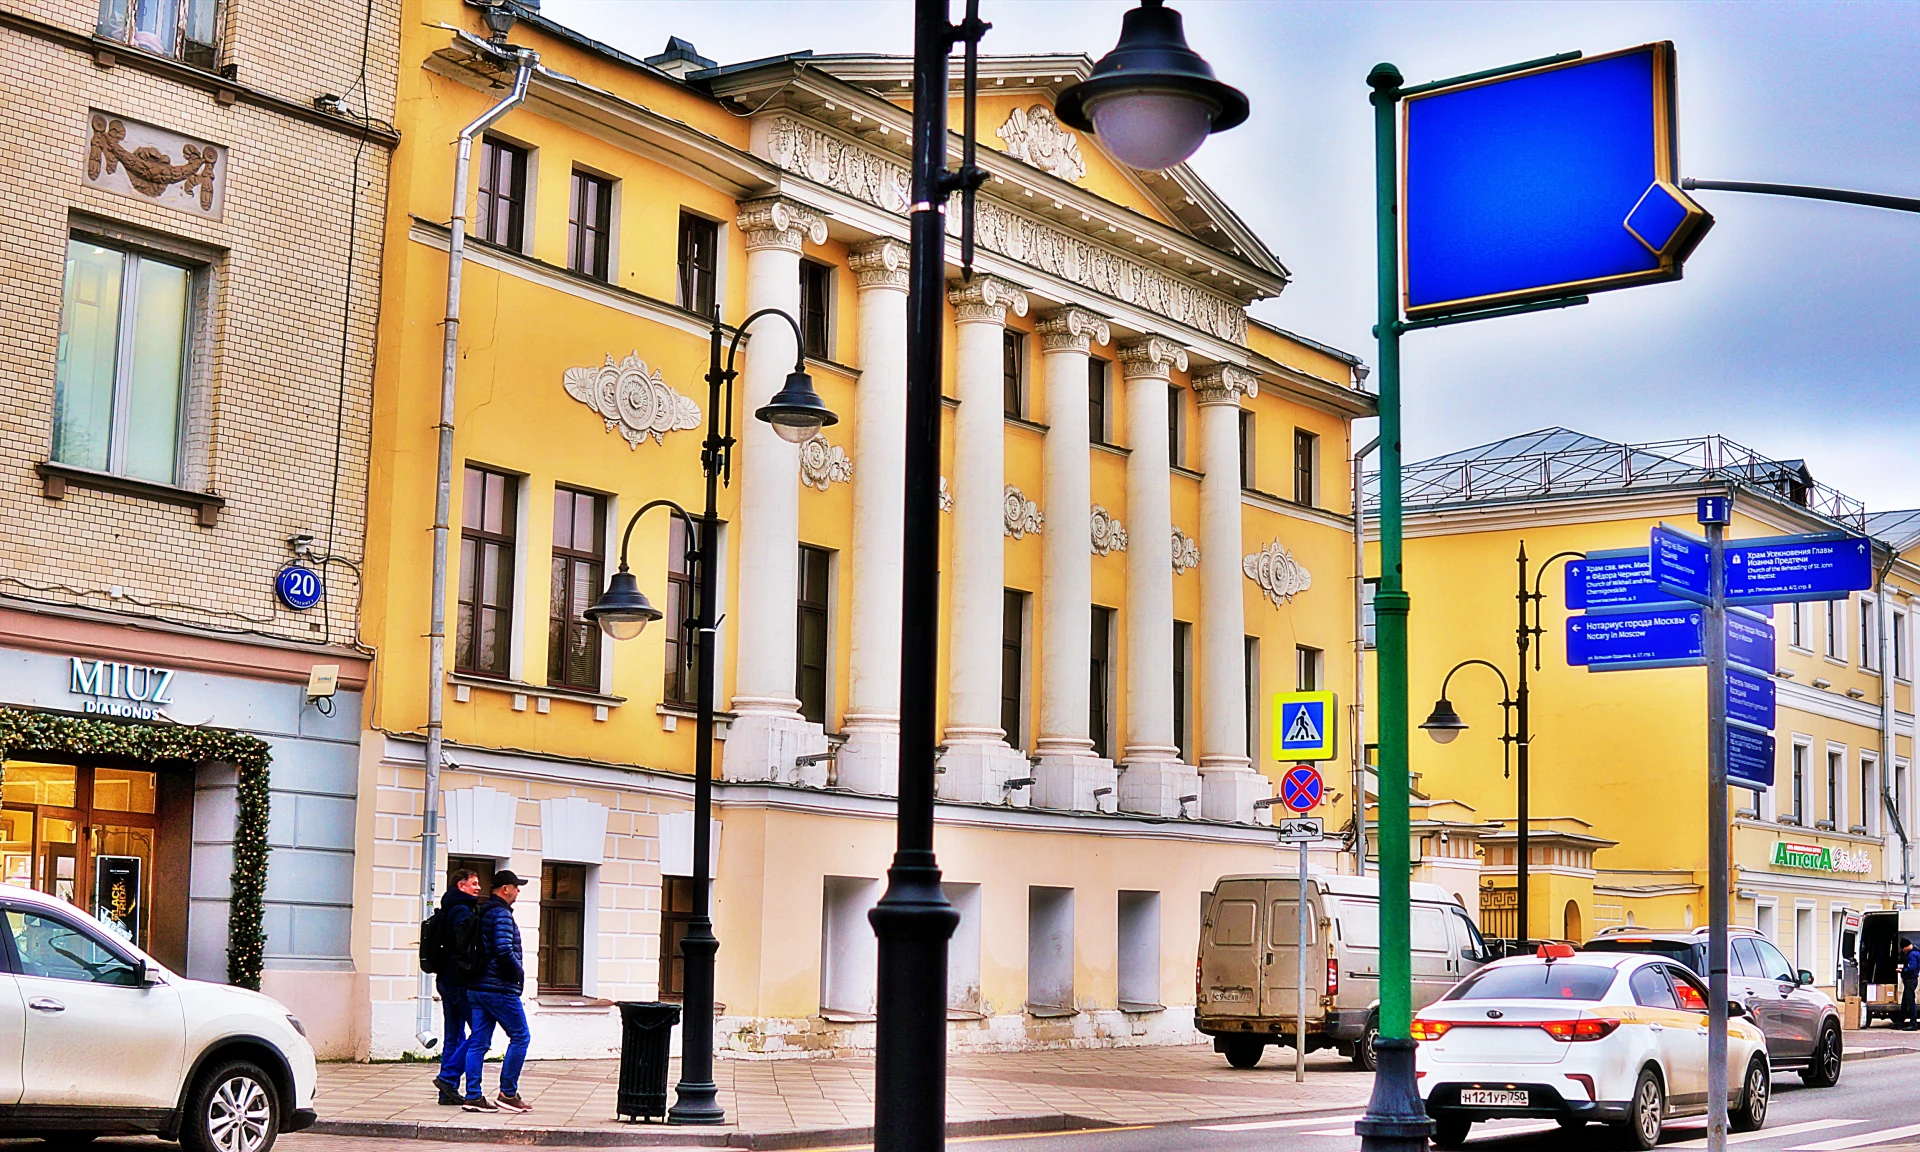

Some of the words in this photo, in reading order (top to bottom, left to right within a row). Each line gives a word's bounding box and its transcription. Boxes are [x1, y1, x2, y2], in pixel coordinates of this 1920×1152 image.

[1747, 552, 1765, 560] Храм
[1766, 549, 1811, 558] Усекновения
[1812, 547, 1833, 555] Главы
[1748, 558, 1773, 566] Иоанна
[1775, 557, 1808, 565] Предтечи
[1586, 565, 1604, 574] Храм
[1748, 566, 1765, 574] Church
[1781, 564, 1807, 572] Beheading
[1592, 572, 1617, 581] Фёдора
[290, 573, 315, 597] 20
[1587, 620, 1623, 631] Нотариус
[1625, 618, 1652, 628] города
[1654, 616, 1685, 626] Москвы
[1587, 631, 1609, 640] Notary
[1619, 630, 1646, 638] Moscow
[70, 656, 174, 705] MIUZ
[84, 700, 159, 721] DIAMONDS
[1488, 1009, 1501, 1017] KIA
[1509, 1092, 1525, 1101] 750
